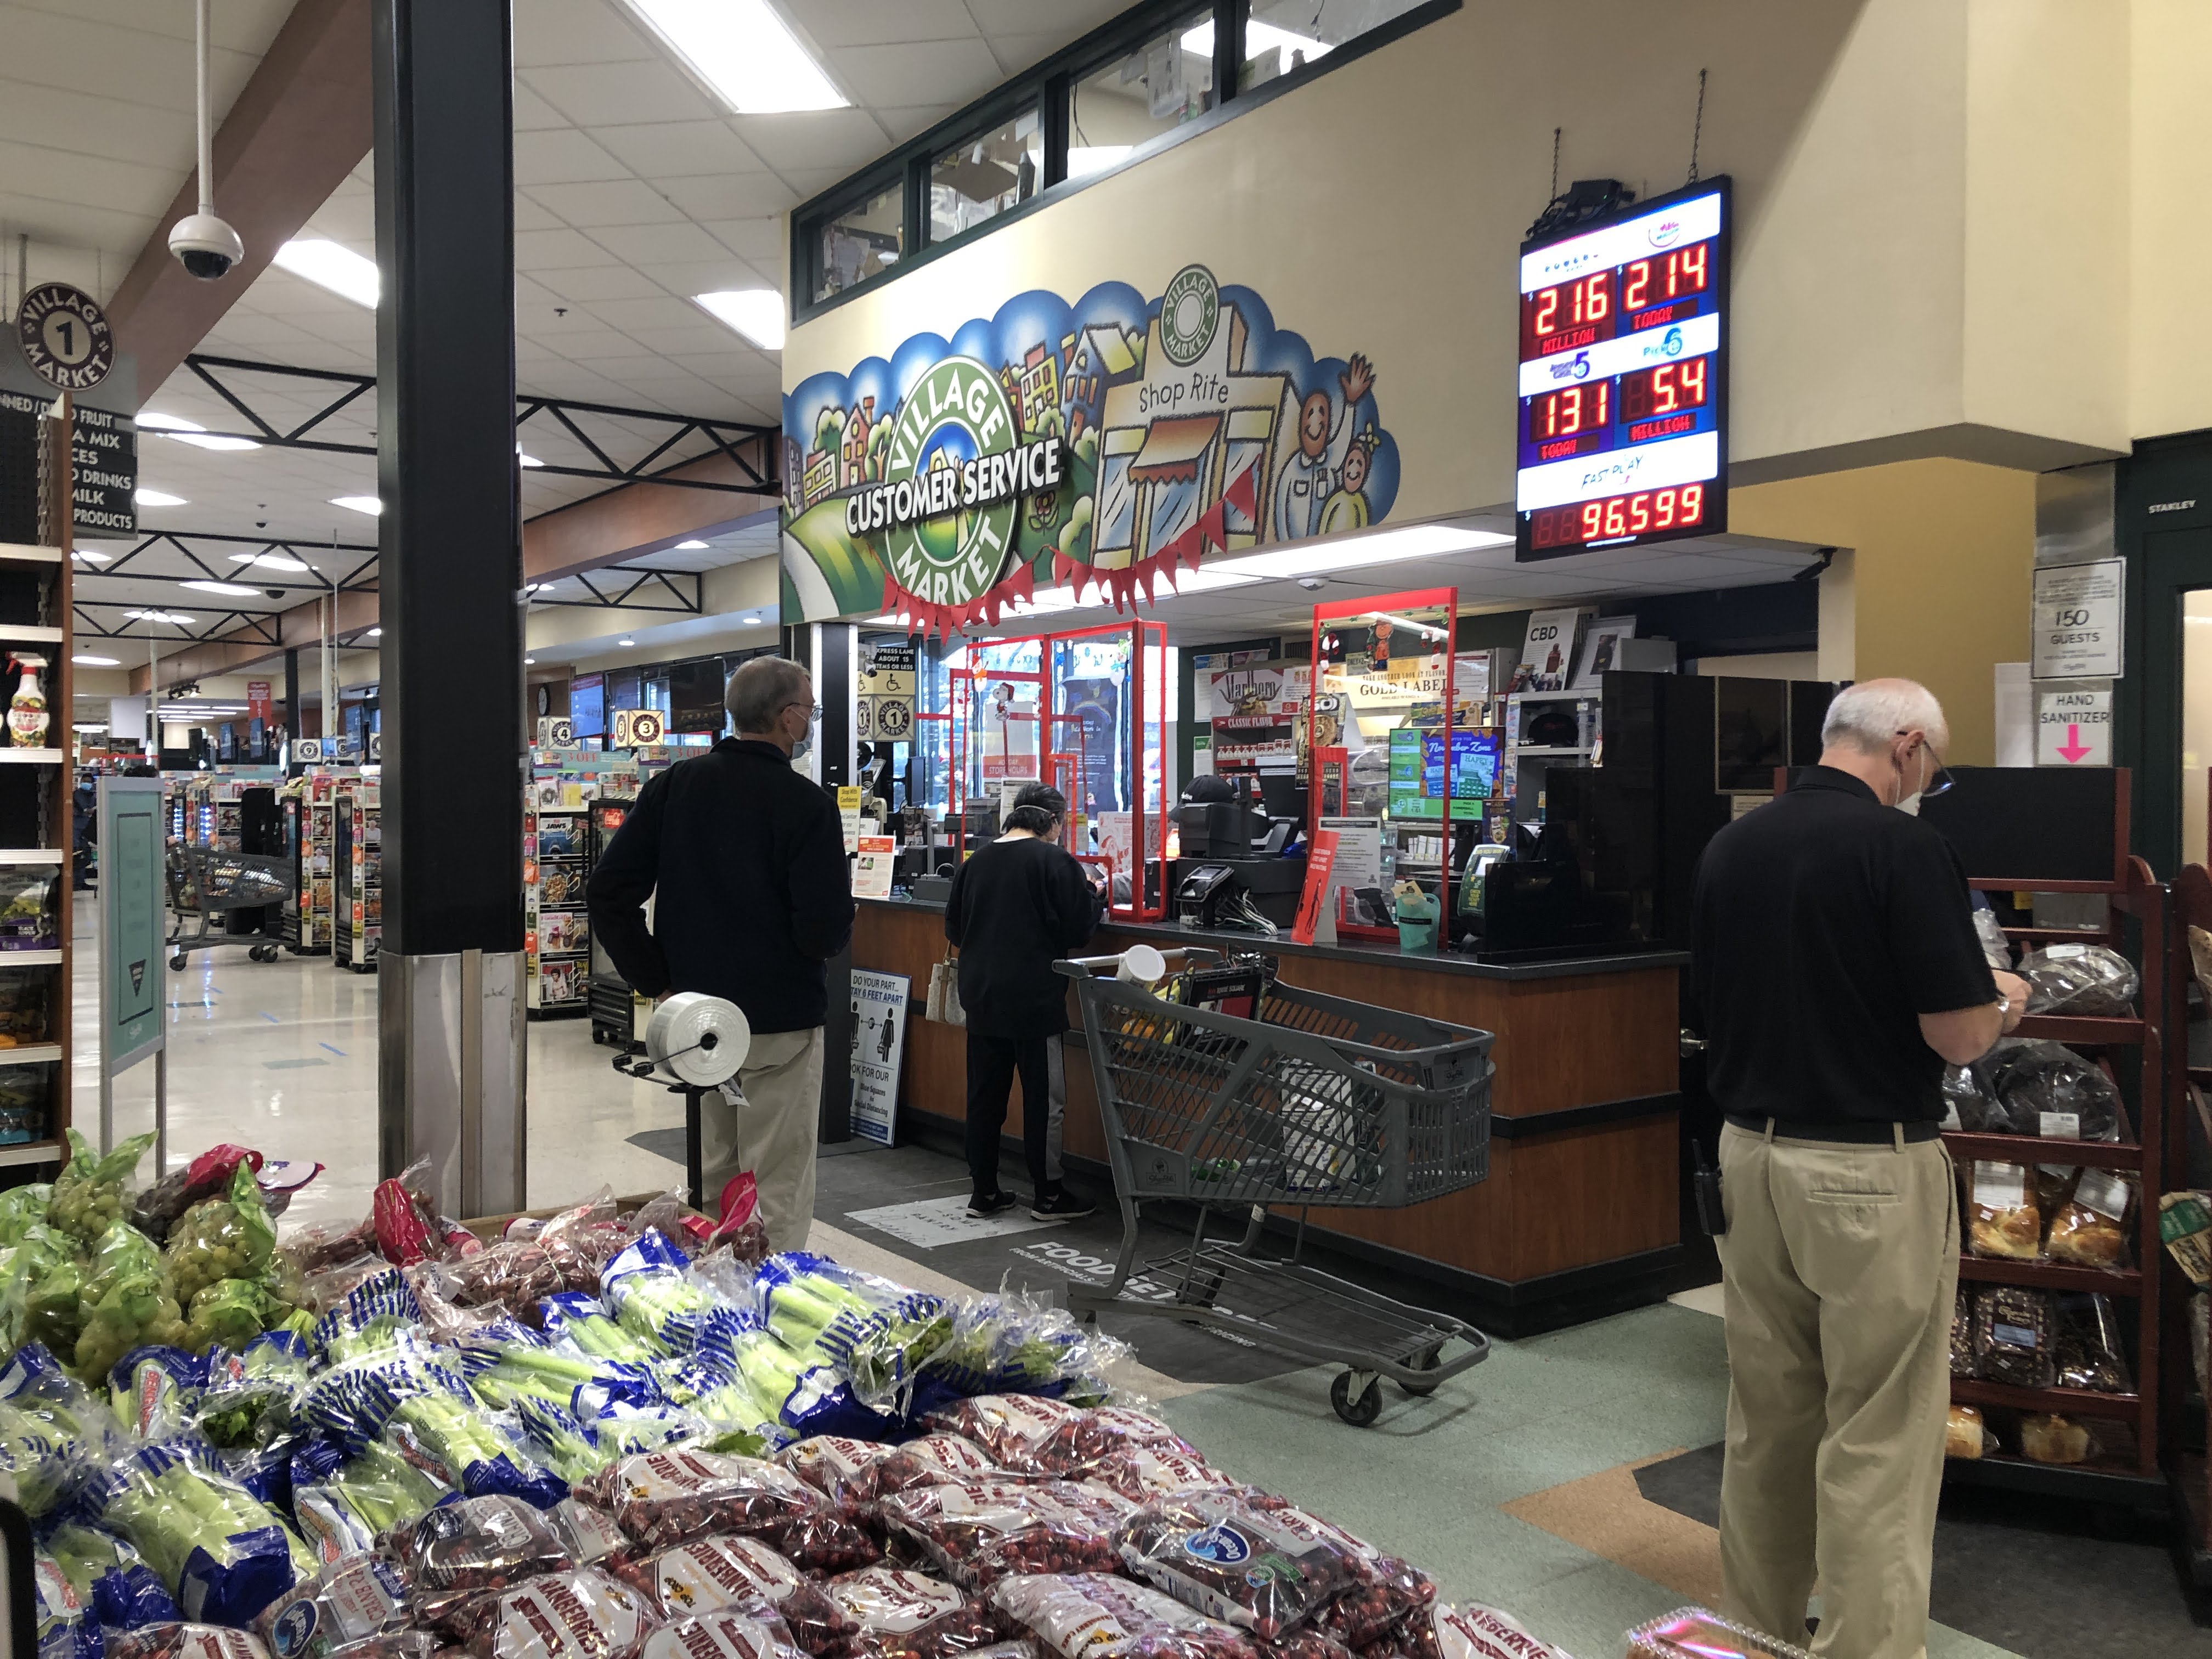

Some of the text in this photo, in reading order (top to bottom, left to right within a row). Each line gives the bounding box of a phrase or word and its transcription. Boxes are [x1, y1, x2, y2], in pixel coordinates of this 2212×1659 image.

[1166, 275, 1212, 308] VILLAGE
[1535, 273, 1608, 336] 216
[1626, 244, 1706, 310] 214
[23, 289, 108, 336] VILLAGE
[55, 320, 74, 356] 1
[1167, 326, 1209, 357] MARKET
[25, 342, 109, 387] MARKET
[1139, 371, 1229, 413] Shop Rite
[1547, 382, 1608, 436] 131
[80, 409, 113, 428] FRUIT
[891, 368, 1005, 471] VILLAGE
[89, 431, 120, 449] MIX
[83, 469, 132, 490] DRINKS
[845, 438, 1060, 535] CUSTOMER SERVICE
[73, 508, 133, 529] PRODUCTS
[897, 516, 1002, 605] MARKET
[2055, 610, 2089, 627] 150
[1530, 625, 1558, 642] CBD
[2050, 632, 2100, 645] GUESTS
[1225, 670, 1276, 699] Marlboro
[1359, 684, 1397, 696] GOLD
[880, 702, 909, 715] VILLAGE
[2055, 694, 2095, 707] HAND
[890, 711, 897, 725] 1
[1228, 716, 1274, 729] CLASSIC FLAVOR
[2040, 710, 2111, 724] SANITIZER
[560, 729, 568, 737] 4
[642, 723, 650, 733] 3
[880, 721, 907, 736] MARKET
[853, 975, 862, 986] DO
[863, 978, 879, 988] YOUR
[862, 990, 867, 998] 6
[867, 991, 883, 1001] FEET
[883, 993, 903, 1005] APART
[862, 1066, 874, 1079] FOR
[875, 1069, 889, 1082] OUR
[860, 1082, 886, 1097] Blue Squares
[867, 1103, 888, 1118] Distancing
[1026, 1242, 1117, 1275] FOOD
